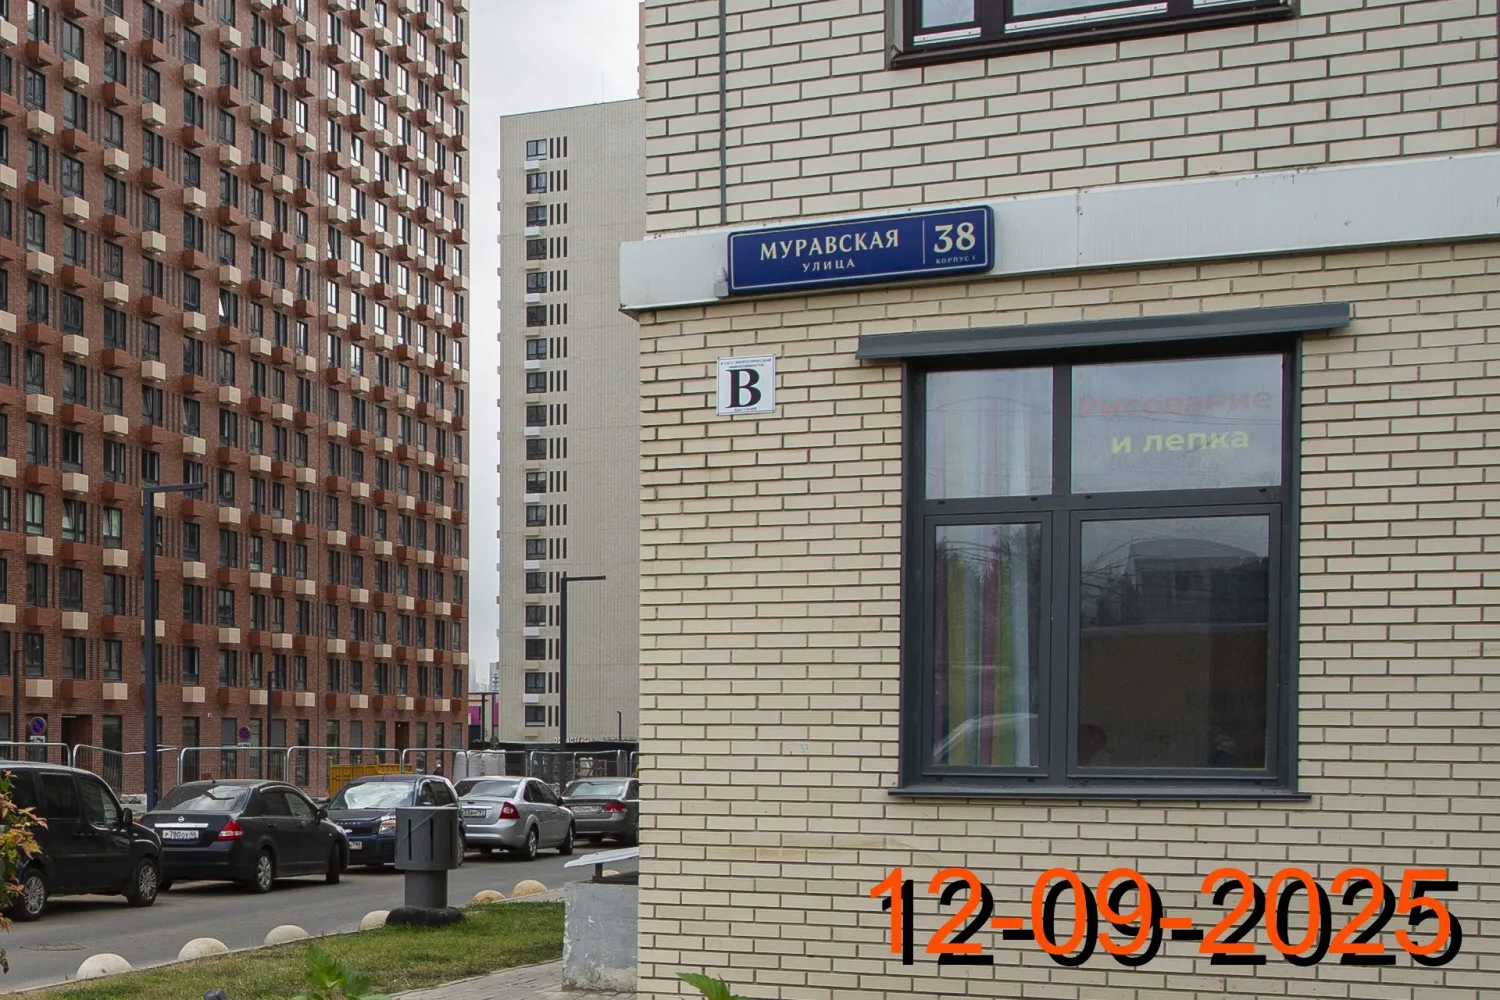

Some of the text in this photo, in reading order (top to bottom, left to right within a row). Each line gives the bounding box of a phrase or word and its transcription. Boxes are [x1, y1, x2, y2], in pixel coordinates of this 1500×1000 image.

[760, 229, 899, 261] МУРАВСКАЯ
[933, 221, 976, 253] 38
[803, 258, 855, 273] УЛИЦА
[936, 255, 970, 264] КОРПУС
[1078, 391, 1273, 419] Рисование
[1111, 430, 1249, 454] и лепка
